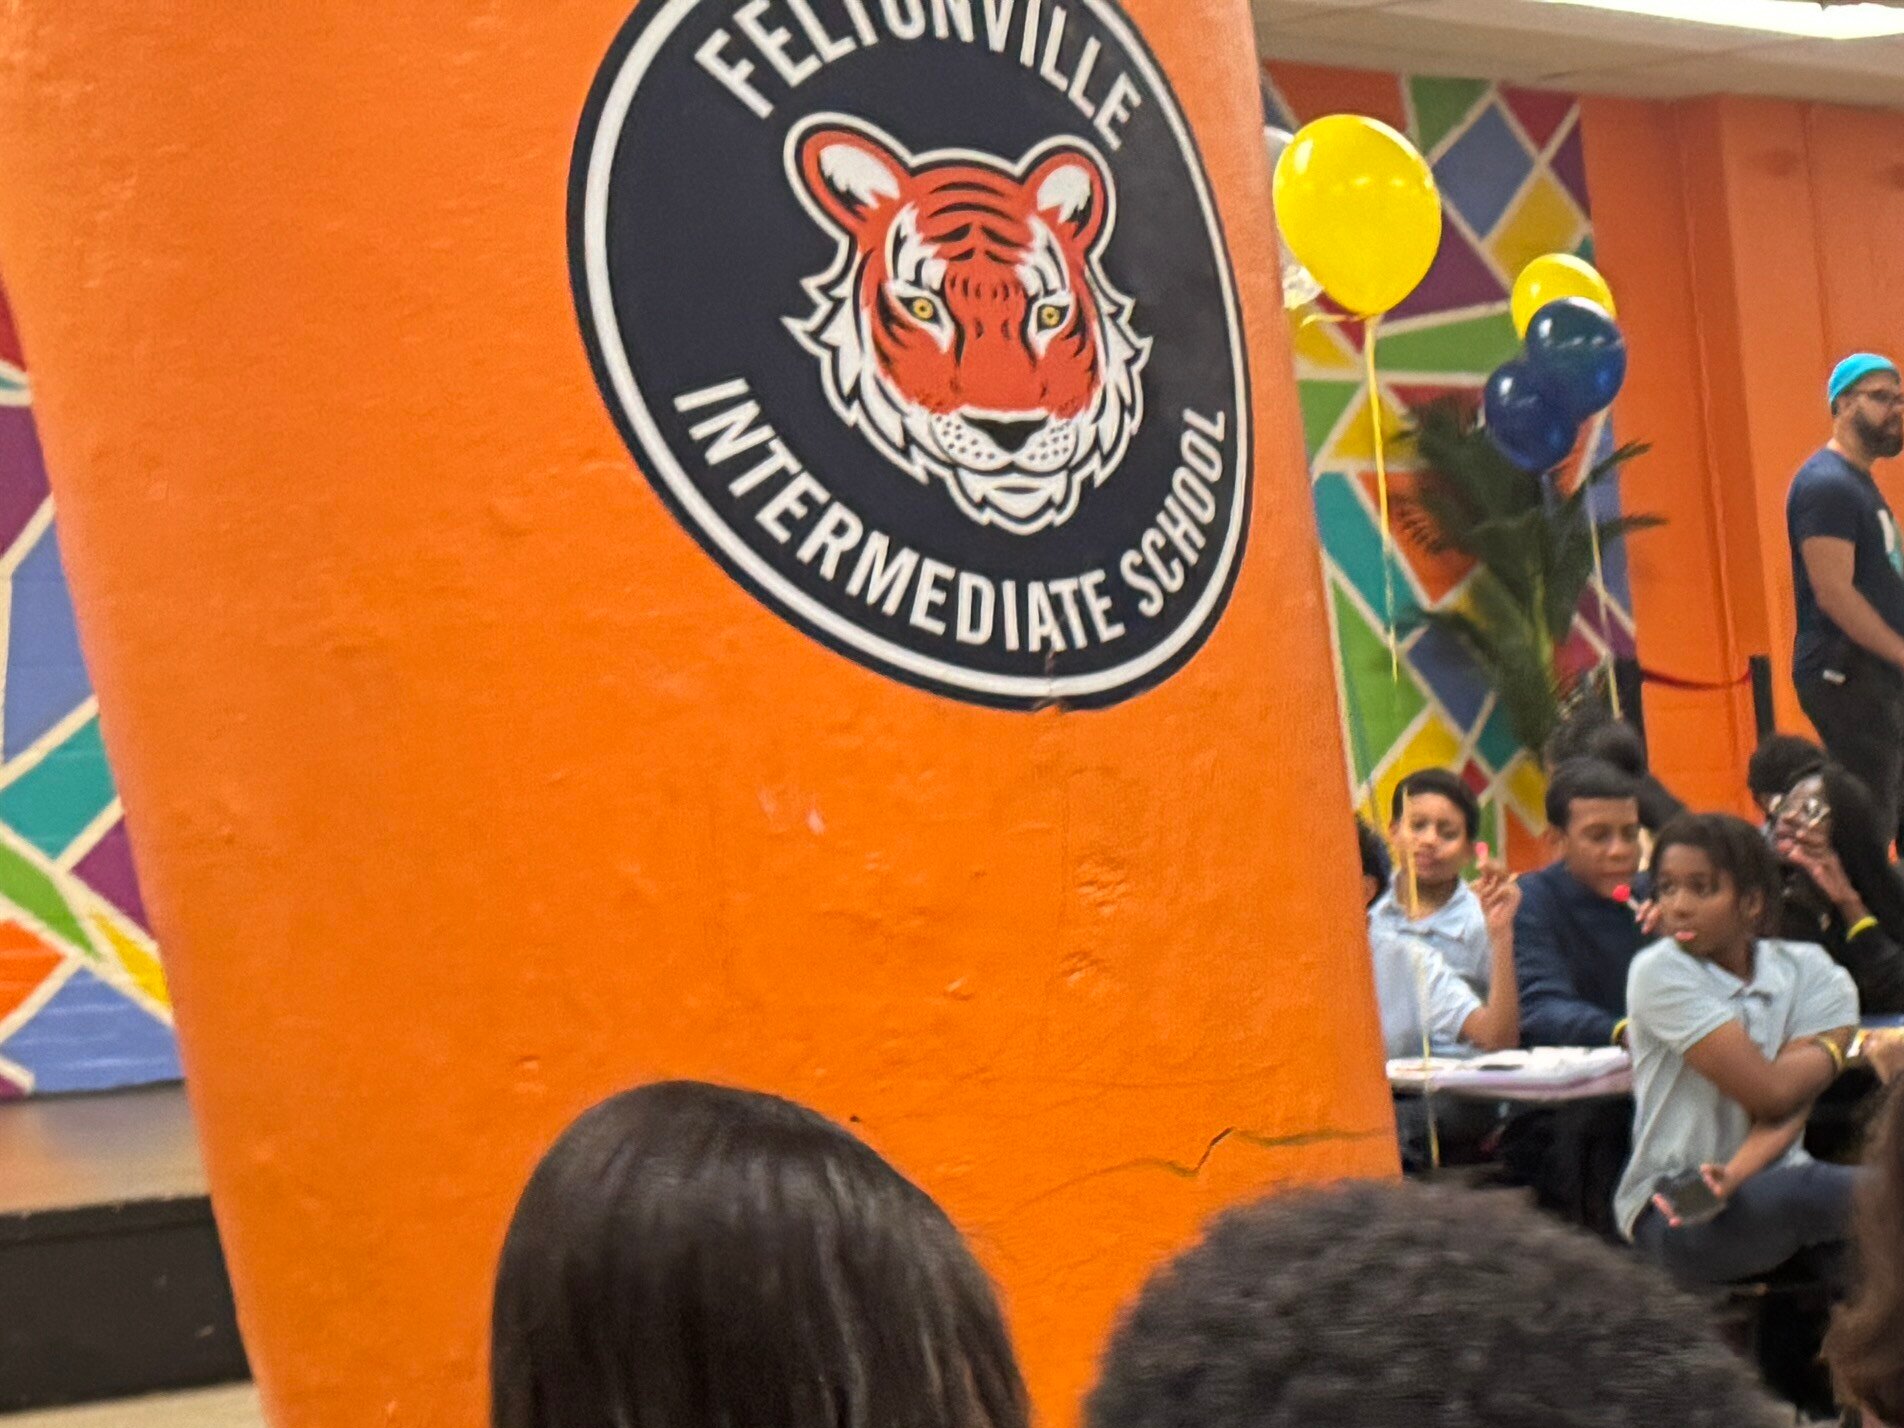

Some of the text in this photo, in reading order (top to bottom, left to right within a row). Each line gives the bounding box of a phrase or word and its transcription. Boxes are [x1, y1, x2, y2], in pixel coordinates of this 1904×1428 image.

[695, 0, 1141, 151] FELTONVILLE
[673, 377, 1227, 652] INTERMEDIATE SCHOOL
